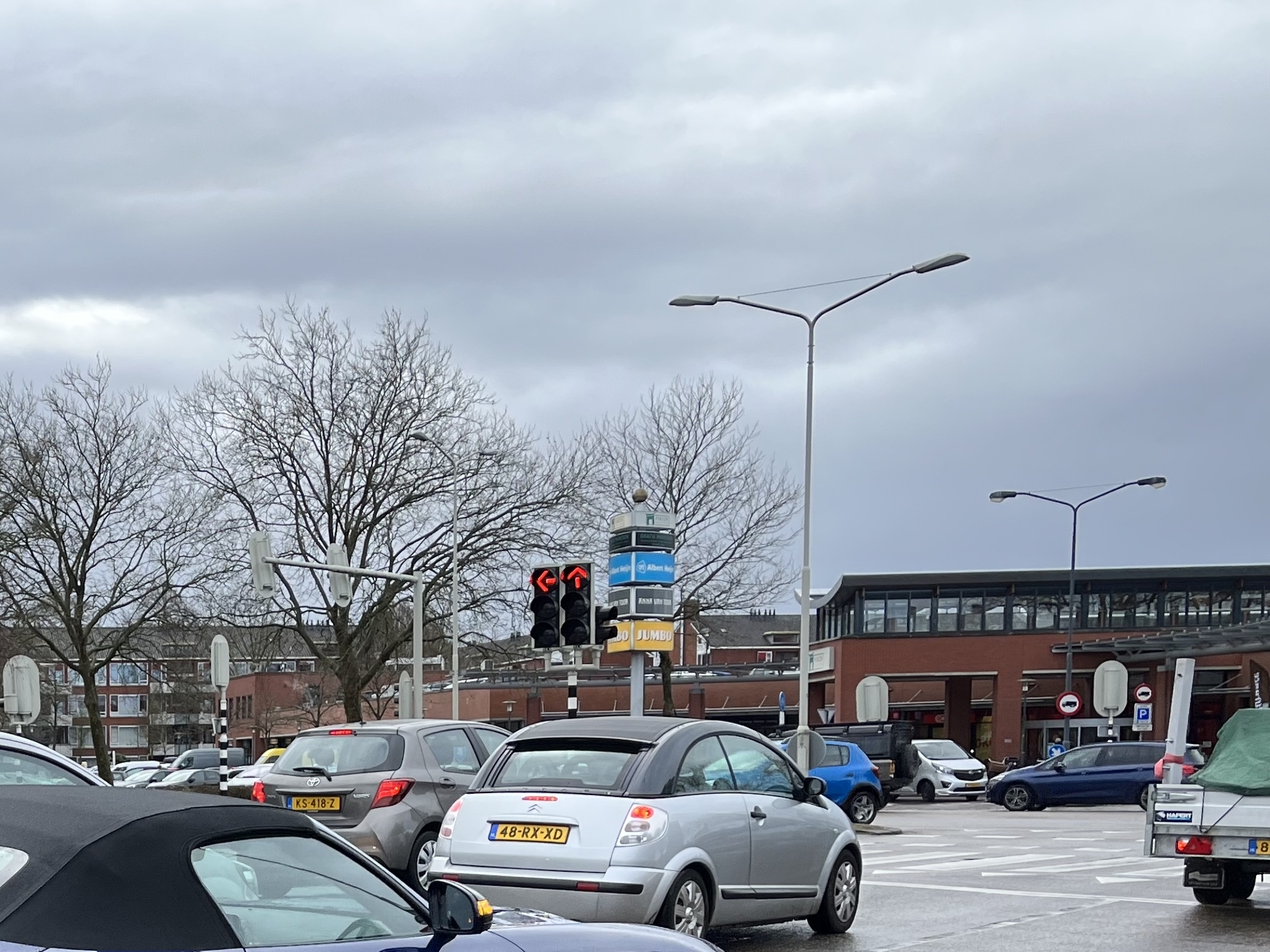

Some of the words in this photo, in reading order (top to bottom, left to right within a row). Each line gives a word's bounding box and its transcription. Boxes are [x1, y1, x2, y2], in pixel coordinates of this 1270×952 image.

[636, 629, 673, 641] JUMBO
[1139, 709, 1147, 719] P
[295, 798, 336, 809] KS-418-Z
[499, 825, 563, 841] 48-RX-XD
